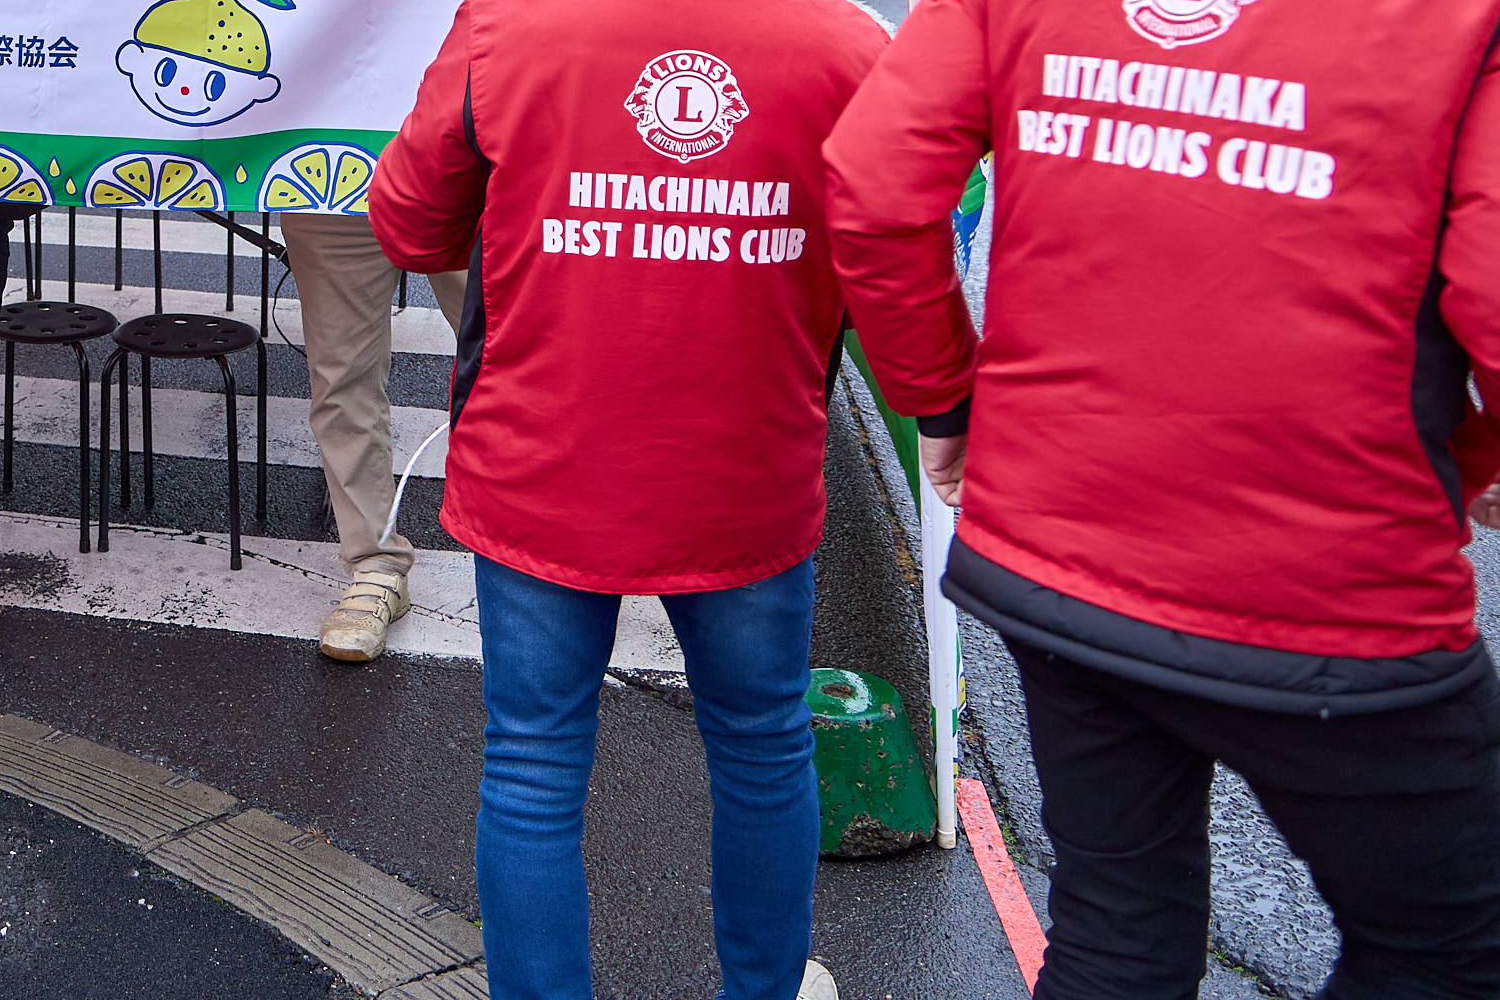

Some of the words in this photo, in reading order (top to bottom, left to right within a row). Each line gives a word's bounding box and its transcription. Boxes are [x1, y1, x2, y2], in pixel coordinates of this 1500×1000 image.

[1135, 9, 1219, 38] INTERNATIONAL
[652, 54, 725, 82] LIONS
[673, 86, 703, 123] L
[1043, 53, 1307, 132] HITACHINAKA
[650, 130, 720, 154] INTERNATIONAL
[1017, 109, 1092, 159] BEST
[1092, 117, 1213, 179] LIONS
[1216, 137, 1337, 201] CLUB
[568, 171, 790, 217] HITACHINAKA
[542, 218, 623, 258] BEST
[632, 223, 732, 262] LIONS
[739, 227, 807, 265] CLUB
